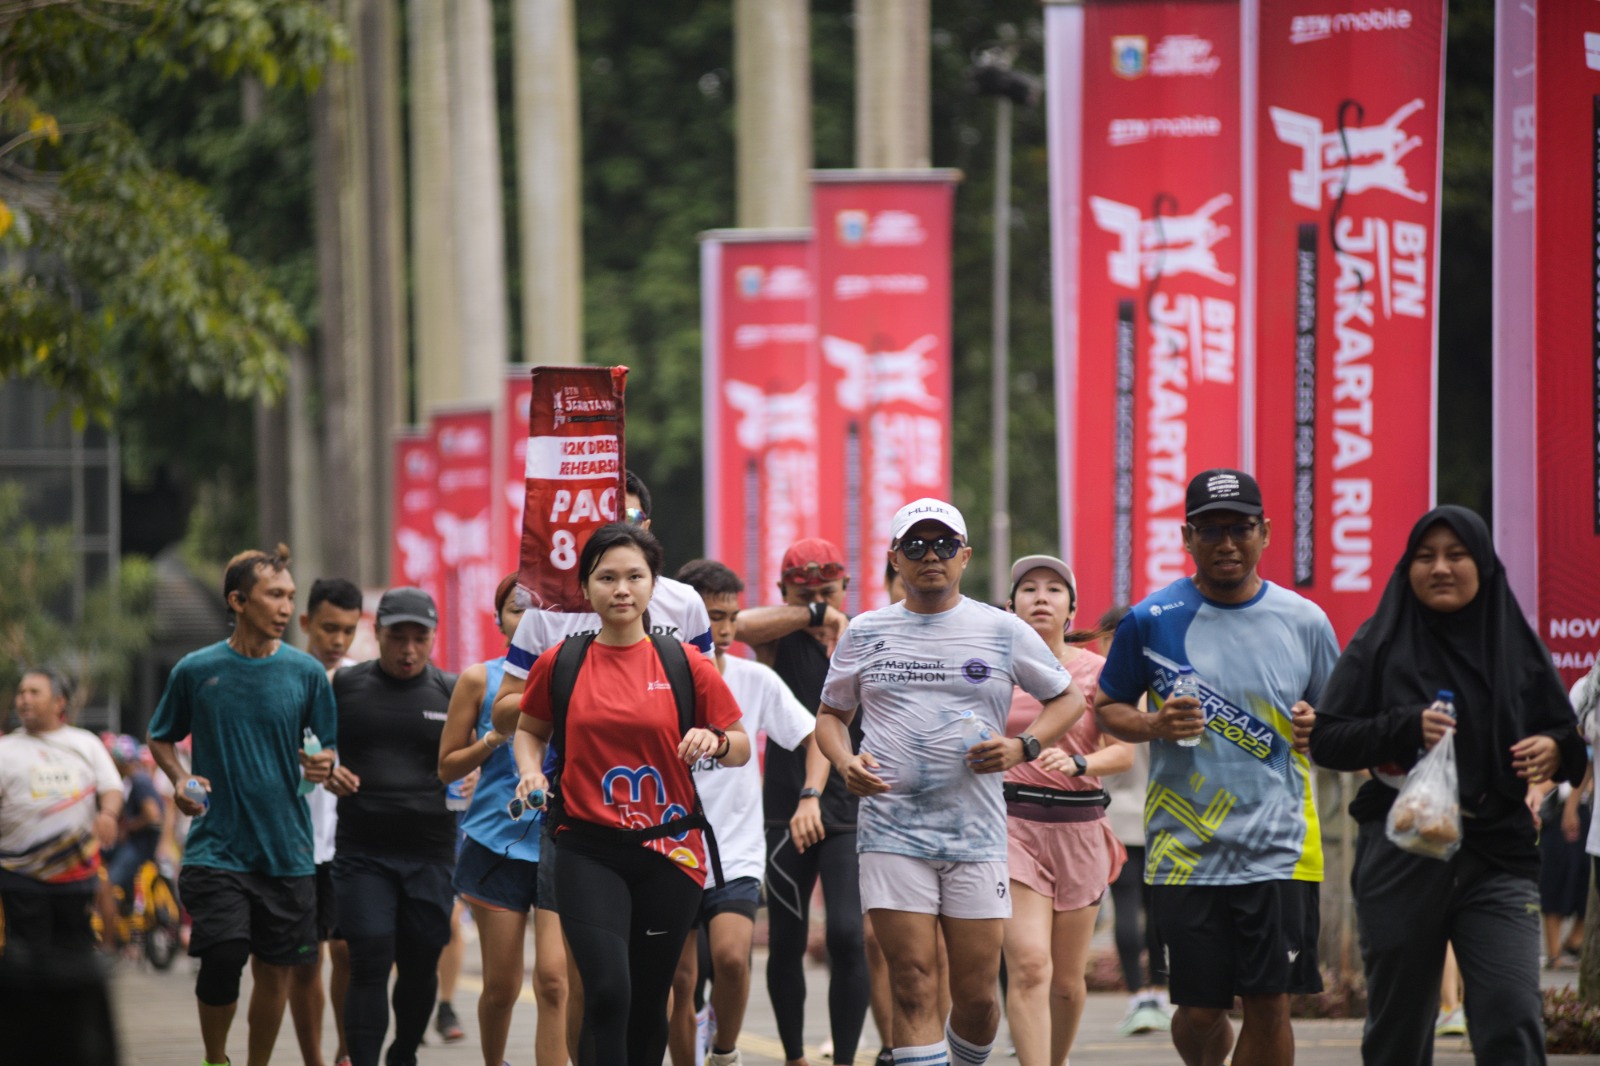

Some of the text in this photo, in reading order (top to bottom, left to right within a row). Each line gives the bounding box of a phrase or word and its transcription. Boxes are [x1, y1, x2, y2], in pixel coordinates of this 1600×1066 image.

[1332, 7, 1412, 33] mobile
[1392, 220, 1427, 318] BTN
[1202, 296, 1235, 384] BTN
[1147, 291, 1188, 514] JAKARTA
[1331, 215, 1375, 592] JAKARTA RUN
[871, 670, 946, 686] MARATHON
[885, 660, 945, 670] Maybank
